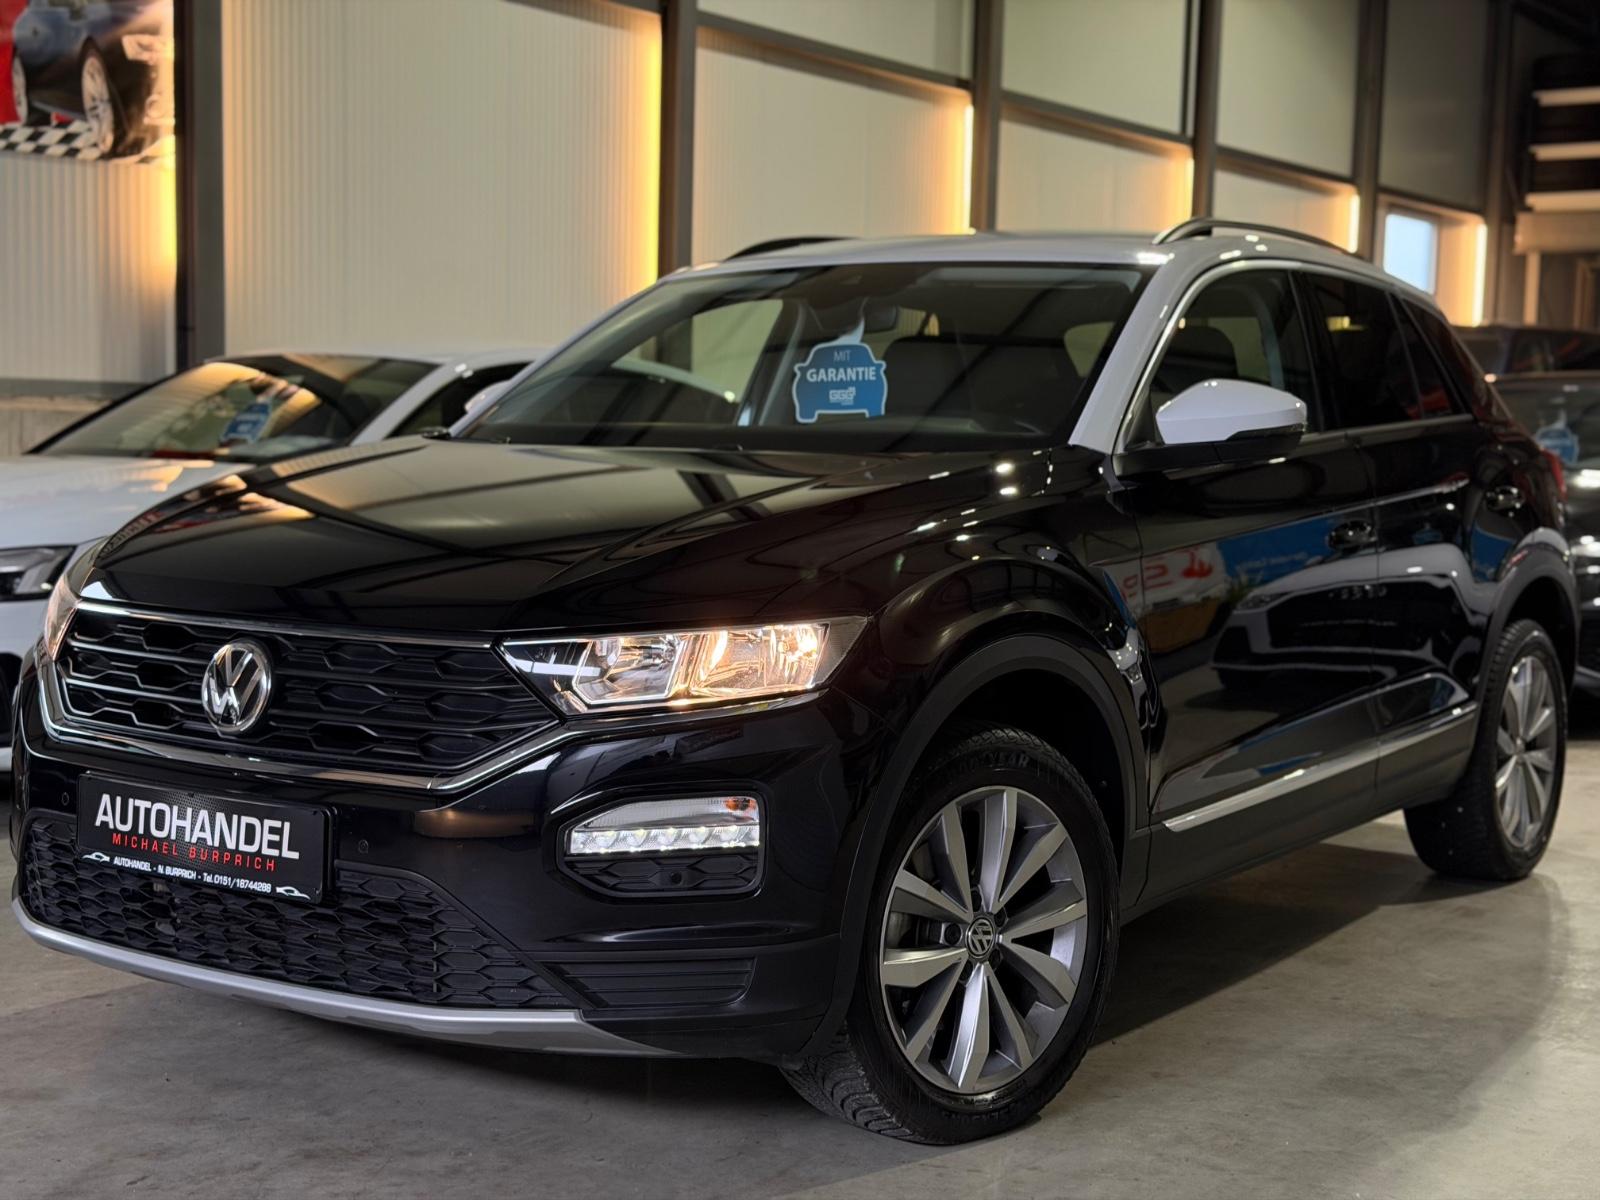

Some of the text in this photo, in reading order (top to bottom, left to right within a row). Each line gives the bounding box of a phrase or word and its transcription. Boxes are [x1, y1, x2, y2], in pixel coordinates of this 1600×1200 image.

[834, 350, 851, 361] MIT
[806, 367, 876, 382] GARANTIE
[95, 793, 299, 859] AUTOHANDEL
[112, 833, 276, 871] MICHAEL BURPRICH
[113, 856, 152, 872] AUTOHANDEL
[165, 866, 196, 880] BURPRICH
